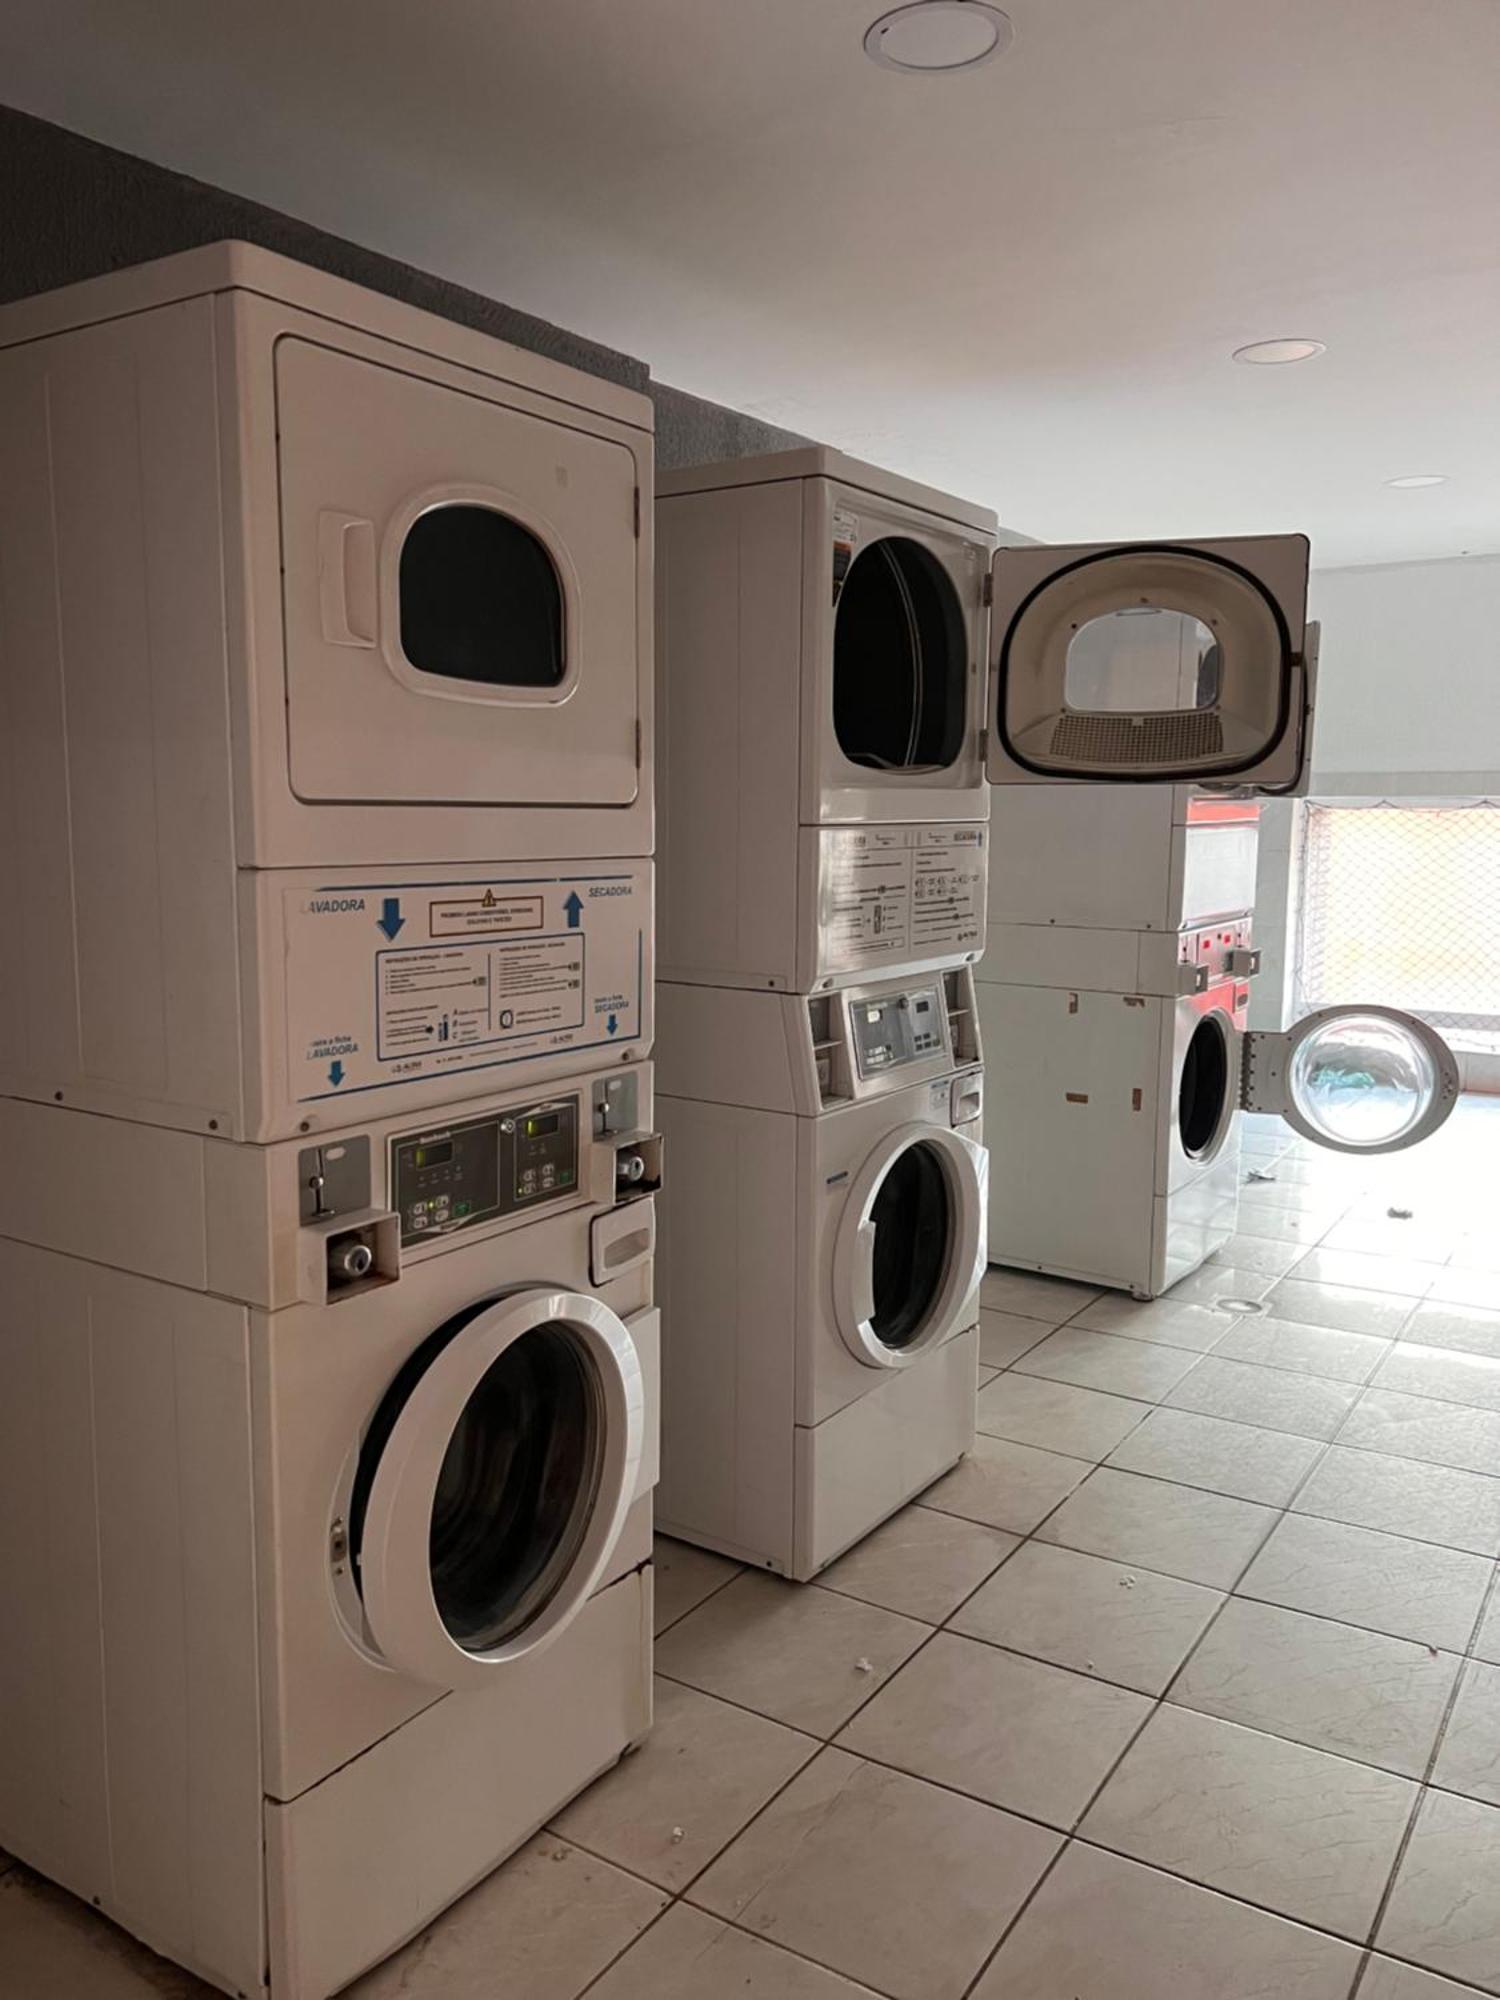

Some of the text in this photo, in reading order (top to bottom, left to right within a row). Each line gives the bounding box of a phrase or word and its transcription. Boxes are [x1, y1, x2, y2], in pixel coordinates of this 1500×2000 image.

[588, 885, 632, 898] SECADORA
[304, 898, 366, 914] AVADORA
[594, 1000, 629, 1014] SECADORA
